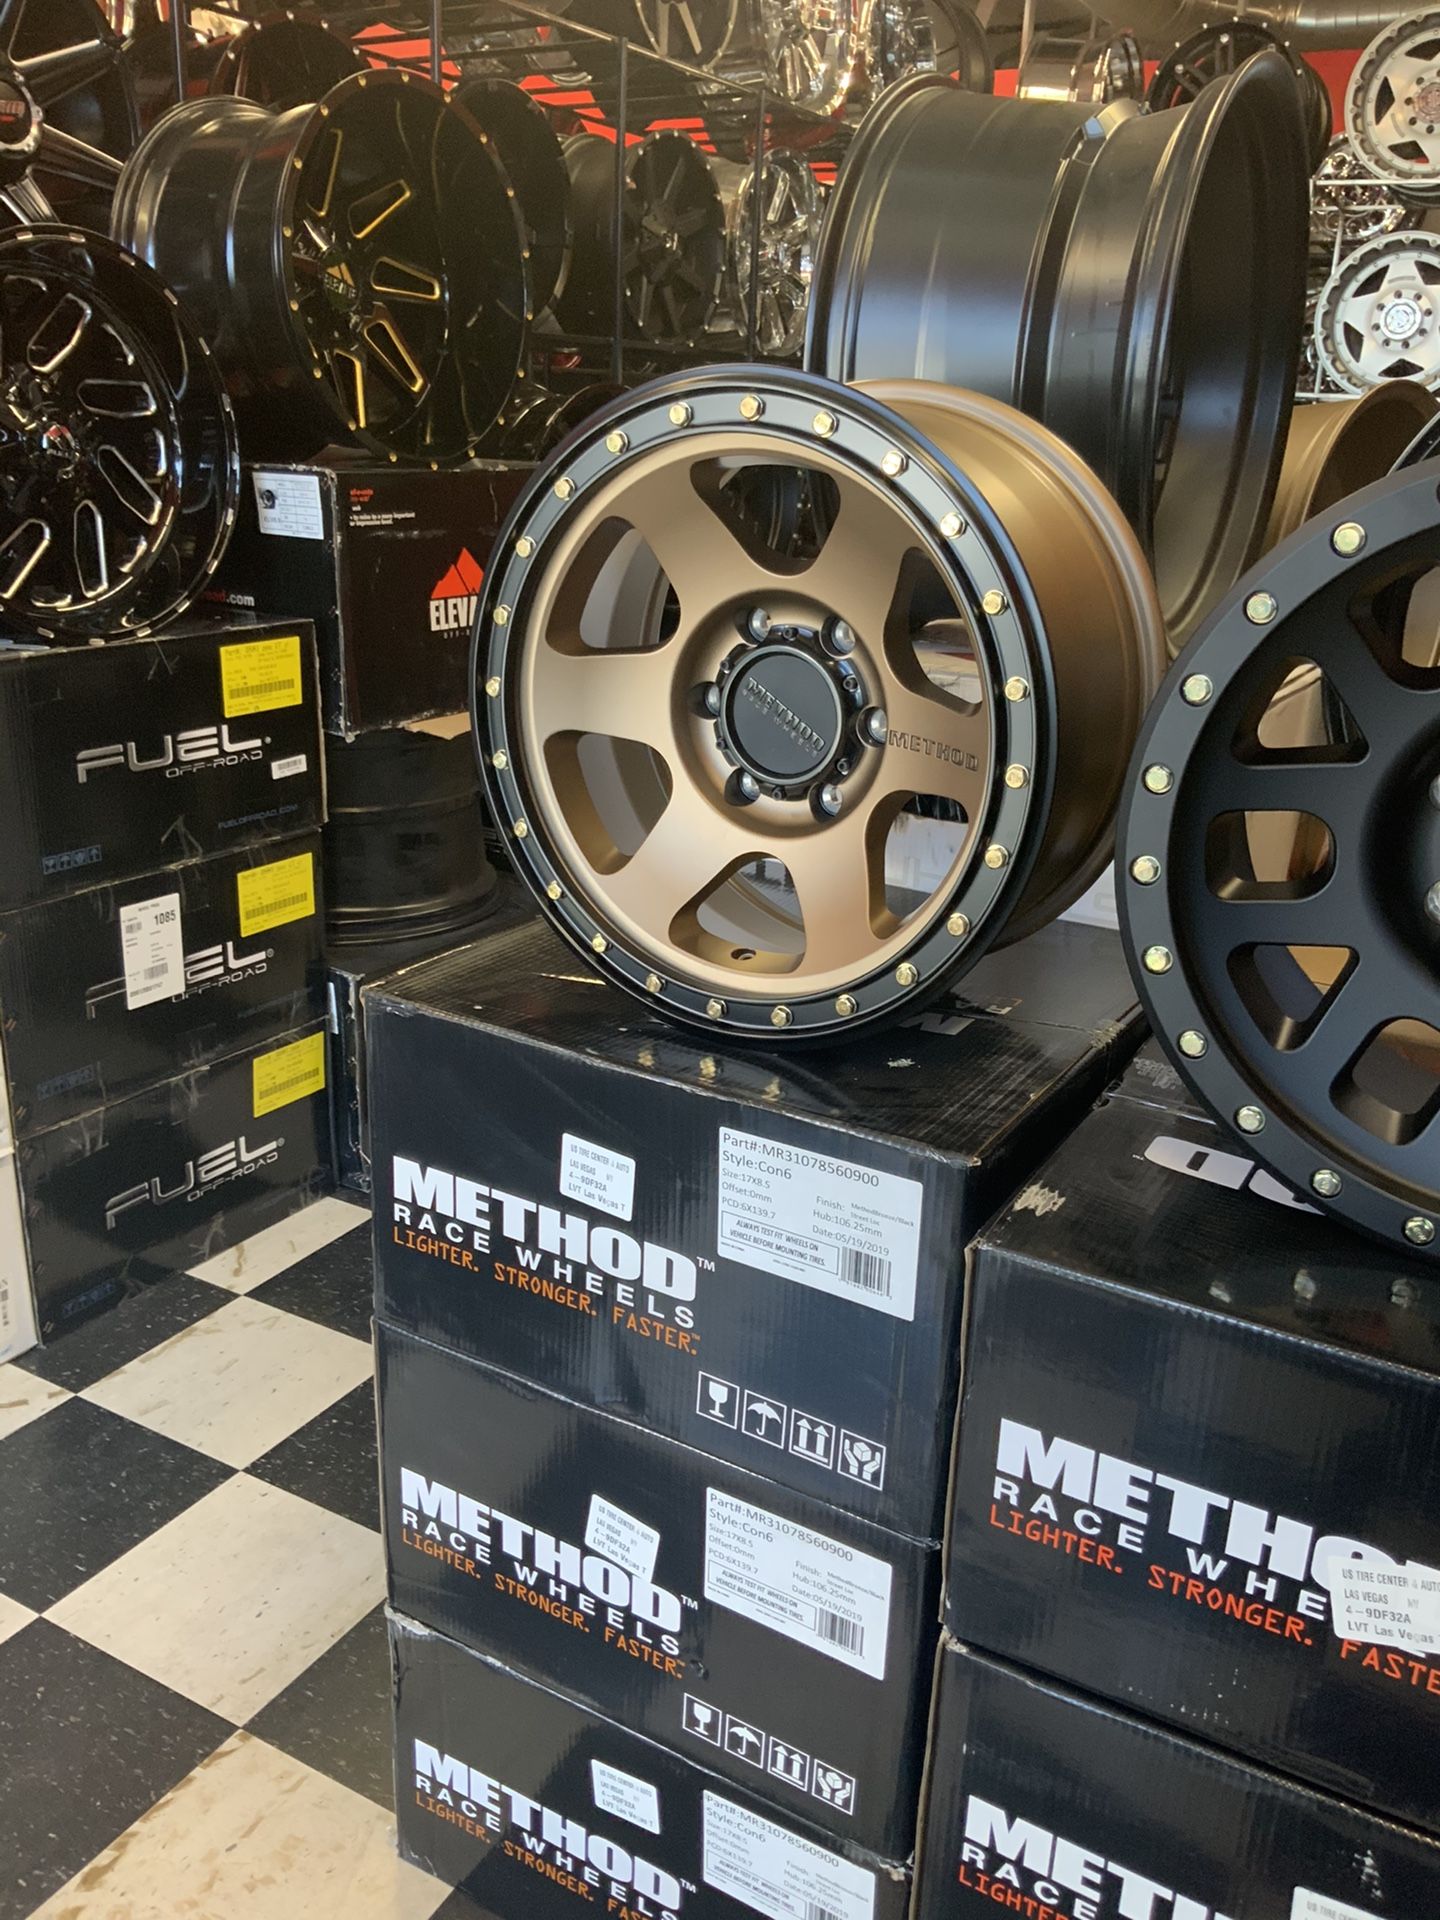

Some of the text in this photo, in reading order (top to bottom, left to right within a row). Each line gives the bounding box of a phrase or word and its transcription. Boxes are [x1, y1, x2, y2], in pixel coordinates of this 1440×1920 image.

[748, 677, 825, 752] METHOD
[77, 724, 262, 784] FUEL
[166, 750, 263, 778] OFF-ROAD
[889, 729, 979, 771] METHOD
[154, 910, 176, 926] 1085
[172, 962, 267, 1003] OFF-ROAD
[105, 1136, 277, 1230] FUEL
[187, 1151, 278, 1202] OFF-ROAD
[721, 1168, 771, 1189] Size:17X8.5
[722, 1150, 792, 1180] Style:Con6
[723, 1133, 880, 1187] Part#:MR31078560900
[721, 1182, 772, 1203] Offset:0mm
[721, 1197, 776, 1219] PCD:6X139.7
[393, 1155, 697, 1302] METHOD
[736, 1219, 760, 1233] ALWAYS
[761, 1226, 774, 1237] TEST
[785, 1235, 808, 1248] WHEELS
[812, 1225, 889, 1256] Date:05/19/2019
[813, 1209, 882, 1238] Hub:106.25mm
[393, 1203, 694, 1329] RACE WHEELS
[393, 1226, 479, 1272] LIGHTER.
[494, 1263, 597, 1316] STRONGER.
[775, 1243, 808, 1260] MOUNTING
[709, 1507, 774, 1543] Style:Con6
[710, 1492, 853, 1562] Part#:MR31078560900
[993, 1476, 1145, 1554] RACE
[401, 1466, 682, 1633] METHOD
[402, 1527, 481, 1580] LIGHTER.
[495, 1574, 590, 1633] STRONGER.
[402, 1508, 680, 1656] RACE WHEELS
[989, 1504, 1440, 1696] LIGHTER. STRONGER. FASTE
[1342, 1569, 1354, 1580] US
[1356, 1570, 1375, 1583] TIRE
[1377, 1574, 1408, 1587] CENTER
[1344, 1588, 1359, 1600] LAS
[1362, 1592, 1389, 1605] VEGAS
[1347, 1621, 1434, 1643] LVT Las Vegas
[415, 1738, 680, 1910] METHOD
[416, 1774, 500, 1832] RACE
[706, 1807, 766, 1843] Style:Con6
[415, 1791, 594, 1902] LIGHTER. STRONGER.
[961, 1841, 1099, 1920] RACE
